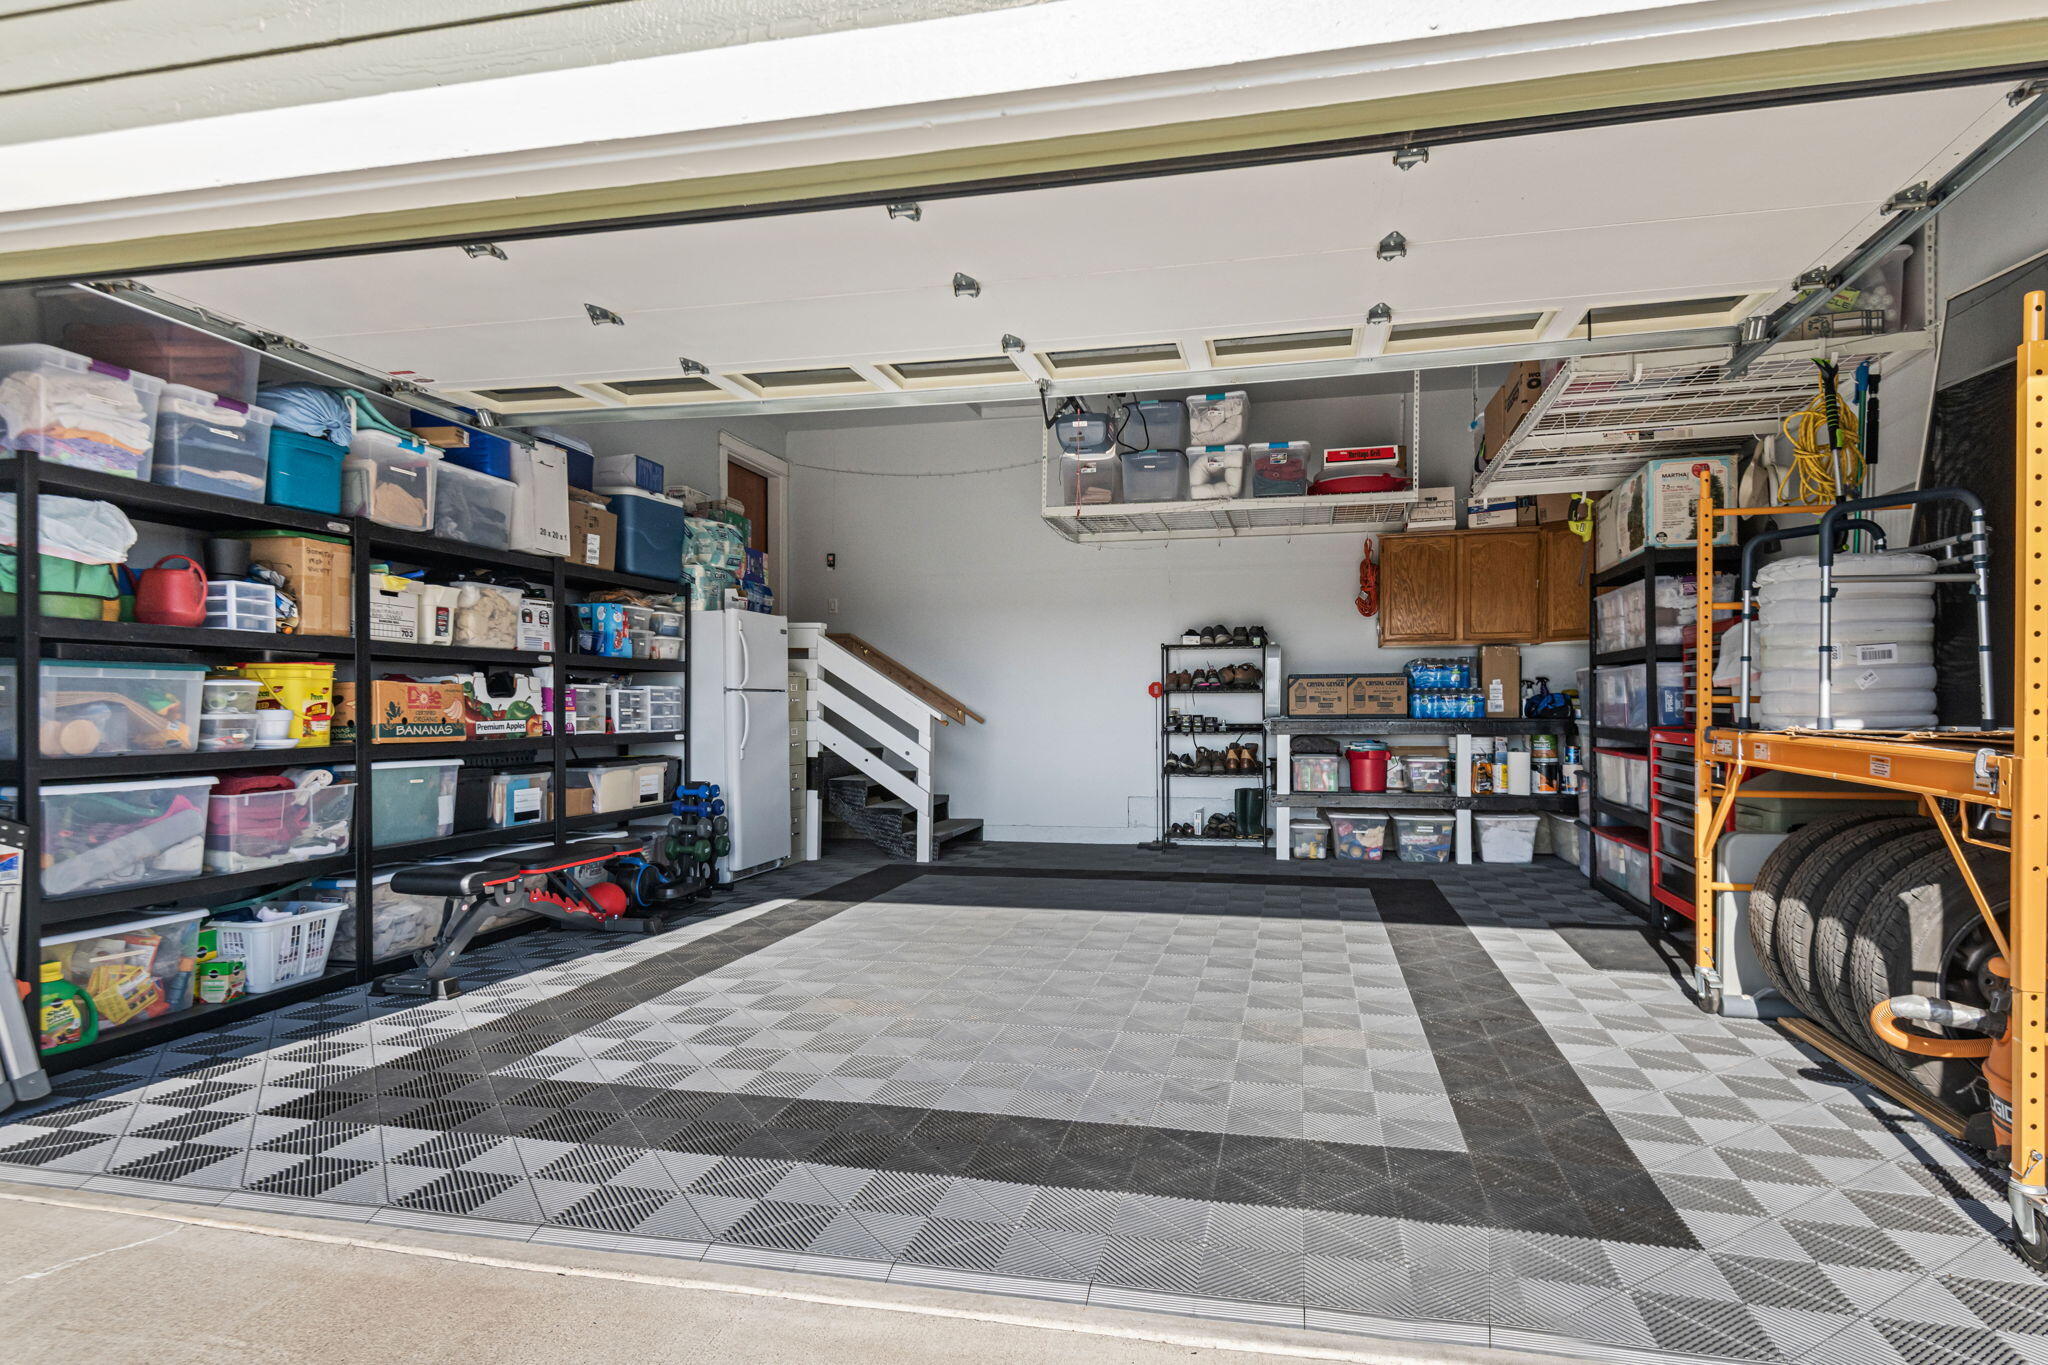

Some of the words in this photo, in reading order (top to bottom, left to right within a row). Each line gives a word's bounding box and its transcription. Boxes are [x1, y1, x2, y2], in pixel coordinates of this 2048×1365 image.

[540, 527, 547, 536] 20
[552, 531, 559, 540] 20
[407, 686, 442, 705] Dole
[396, 725, 453, 736] BANANAS
[476, 723, 505, 732] Premium
[506, 721, 526, 731] Apples
